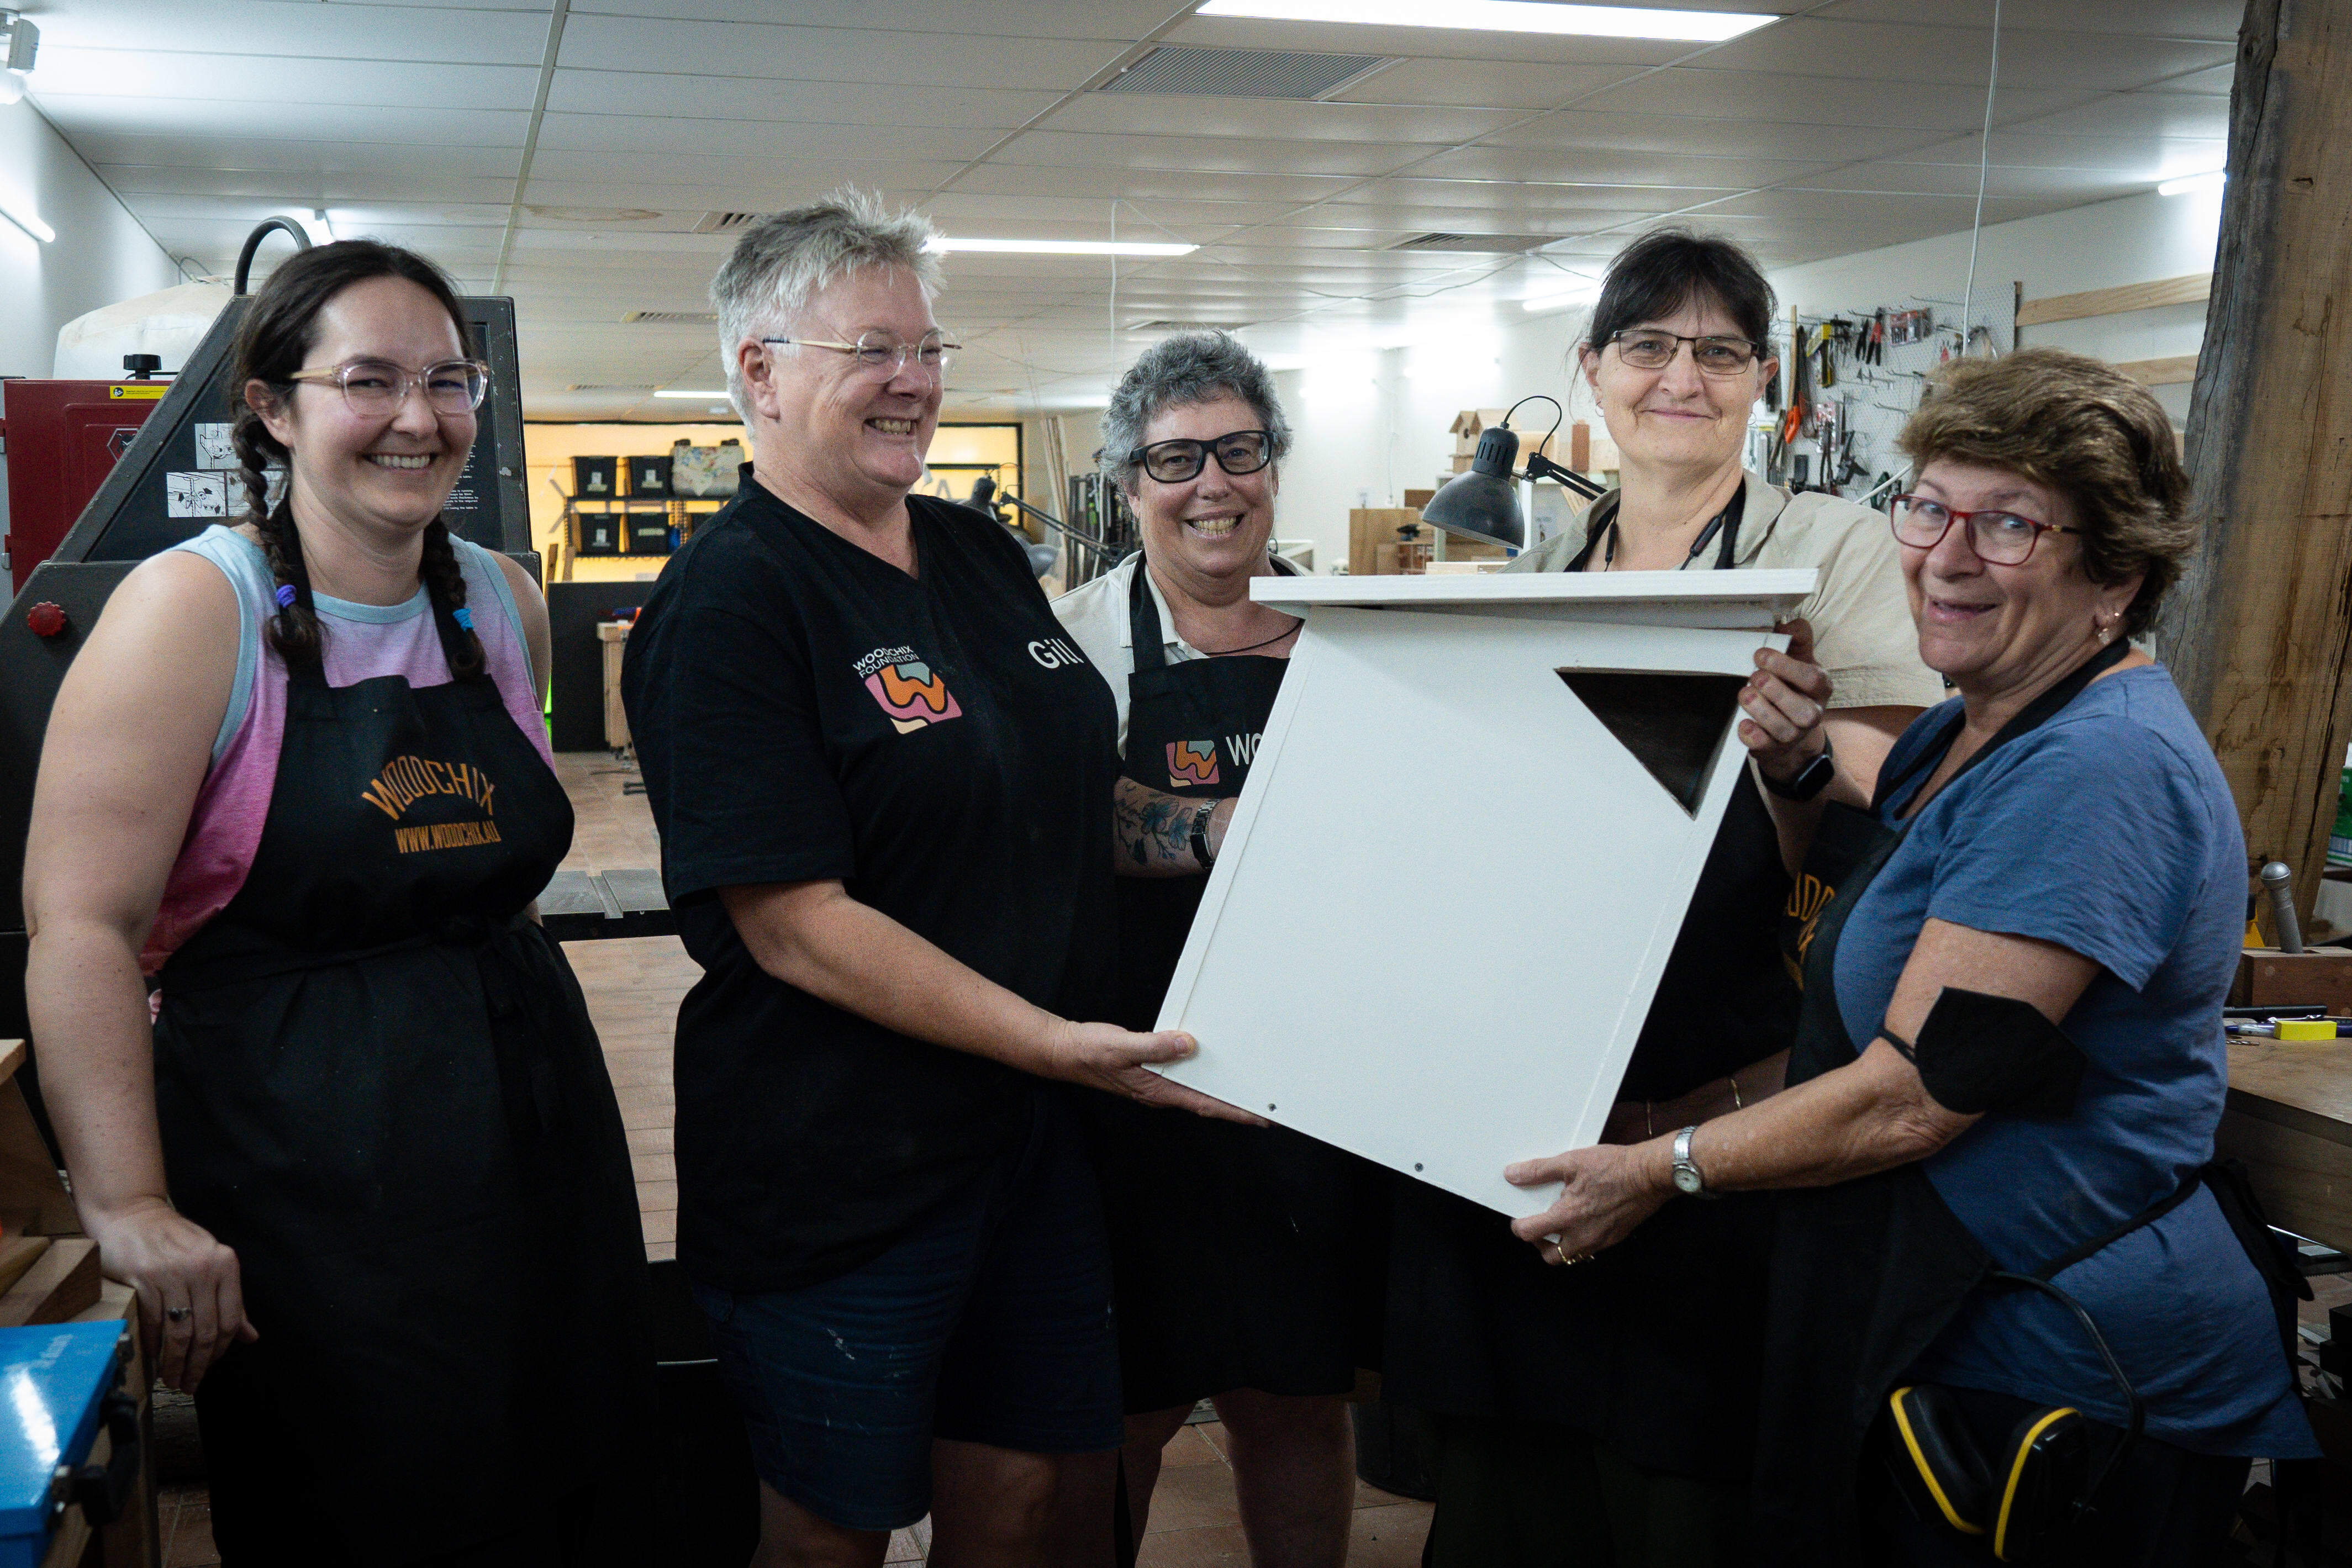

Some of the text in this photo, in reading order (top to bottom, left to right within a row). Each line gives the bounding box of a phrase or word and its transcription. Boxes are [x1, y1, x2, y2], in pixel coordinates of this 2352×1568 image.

[852, 645, 914, 671] WOODCHIX
[858, 653, 920, 678] FOUNDATION
[1028, 638, 1084, 669] Gill
[361, 755, 495, 821] WOODCHIX
